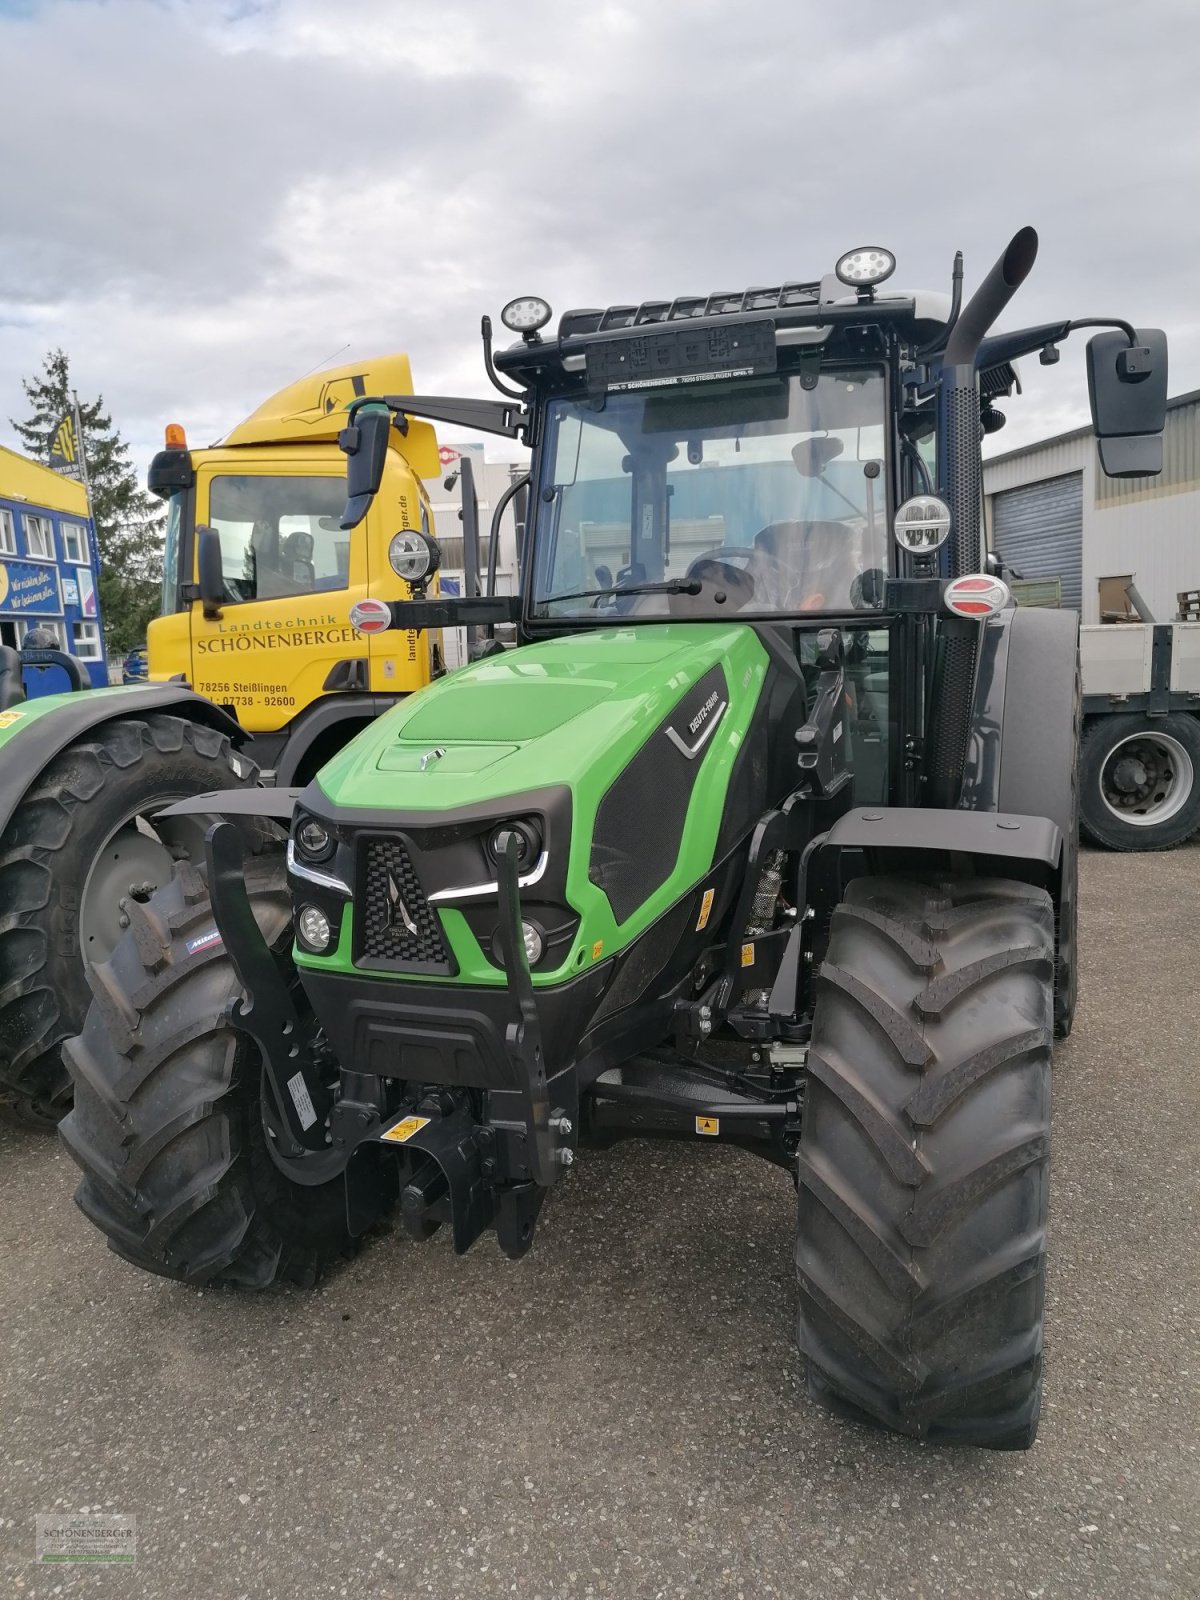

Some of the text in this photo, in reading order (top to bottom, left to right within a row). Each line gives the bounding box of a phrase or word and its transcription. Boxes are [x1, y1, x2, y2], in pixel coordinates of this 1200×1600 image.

[219, 614, 337, 633] Landtechnik
[198, 628, 362, 654] SCHÖNENBERGER
[199, 682, 287, 694] 78256 Steißlingen
[223, 696, 253, 706] 07738
[264, 696, 295, 706] 92600
[689, 691, 719, 734] DEUTZ-FAHR
